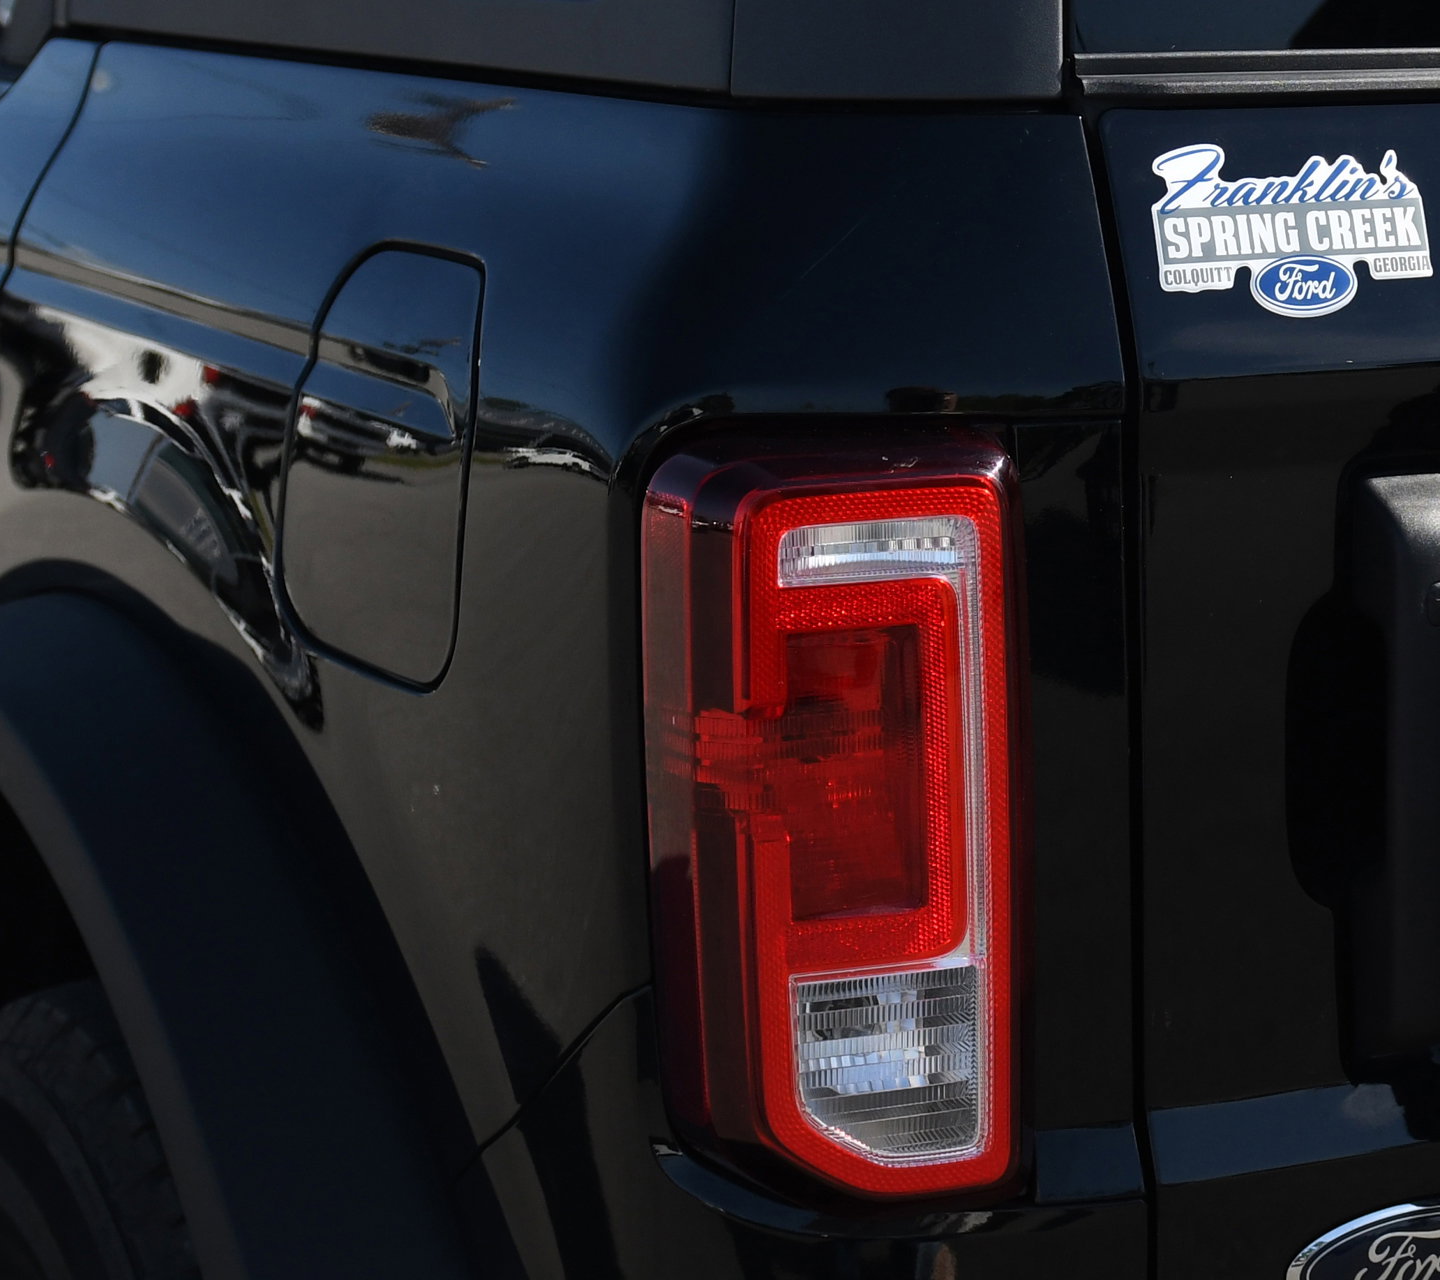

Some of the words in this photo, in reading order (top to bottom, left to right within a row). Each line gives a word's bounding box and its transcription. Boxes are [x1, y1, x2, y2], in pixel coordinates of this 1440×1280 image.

[1157, 148, 1415, 215] Franklin's
[1165, 210, 1299, 259] SPRING
[1306, 205, 1422, 251] CREEK
[1164, 267, 1234, 286] COLQUITT
[1274, 263, 1336, 301] Ford
[1373, 255, 1431, 274] GEORGIA
